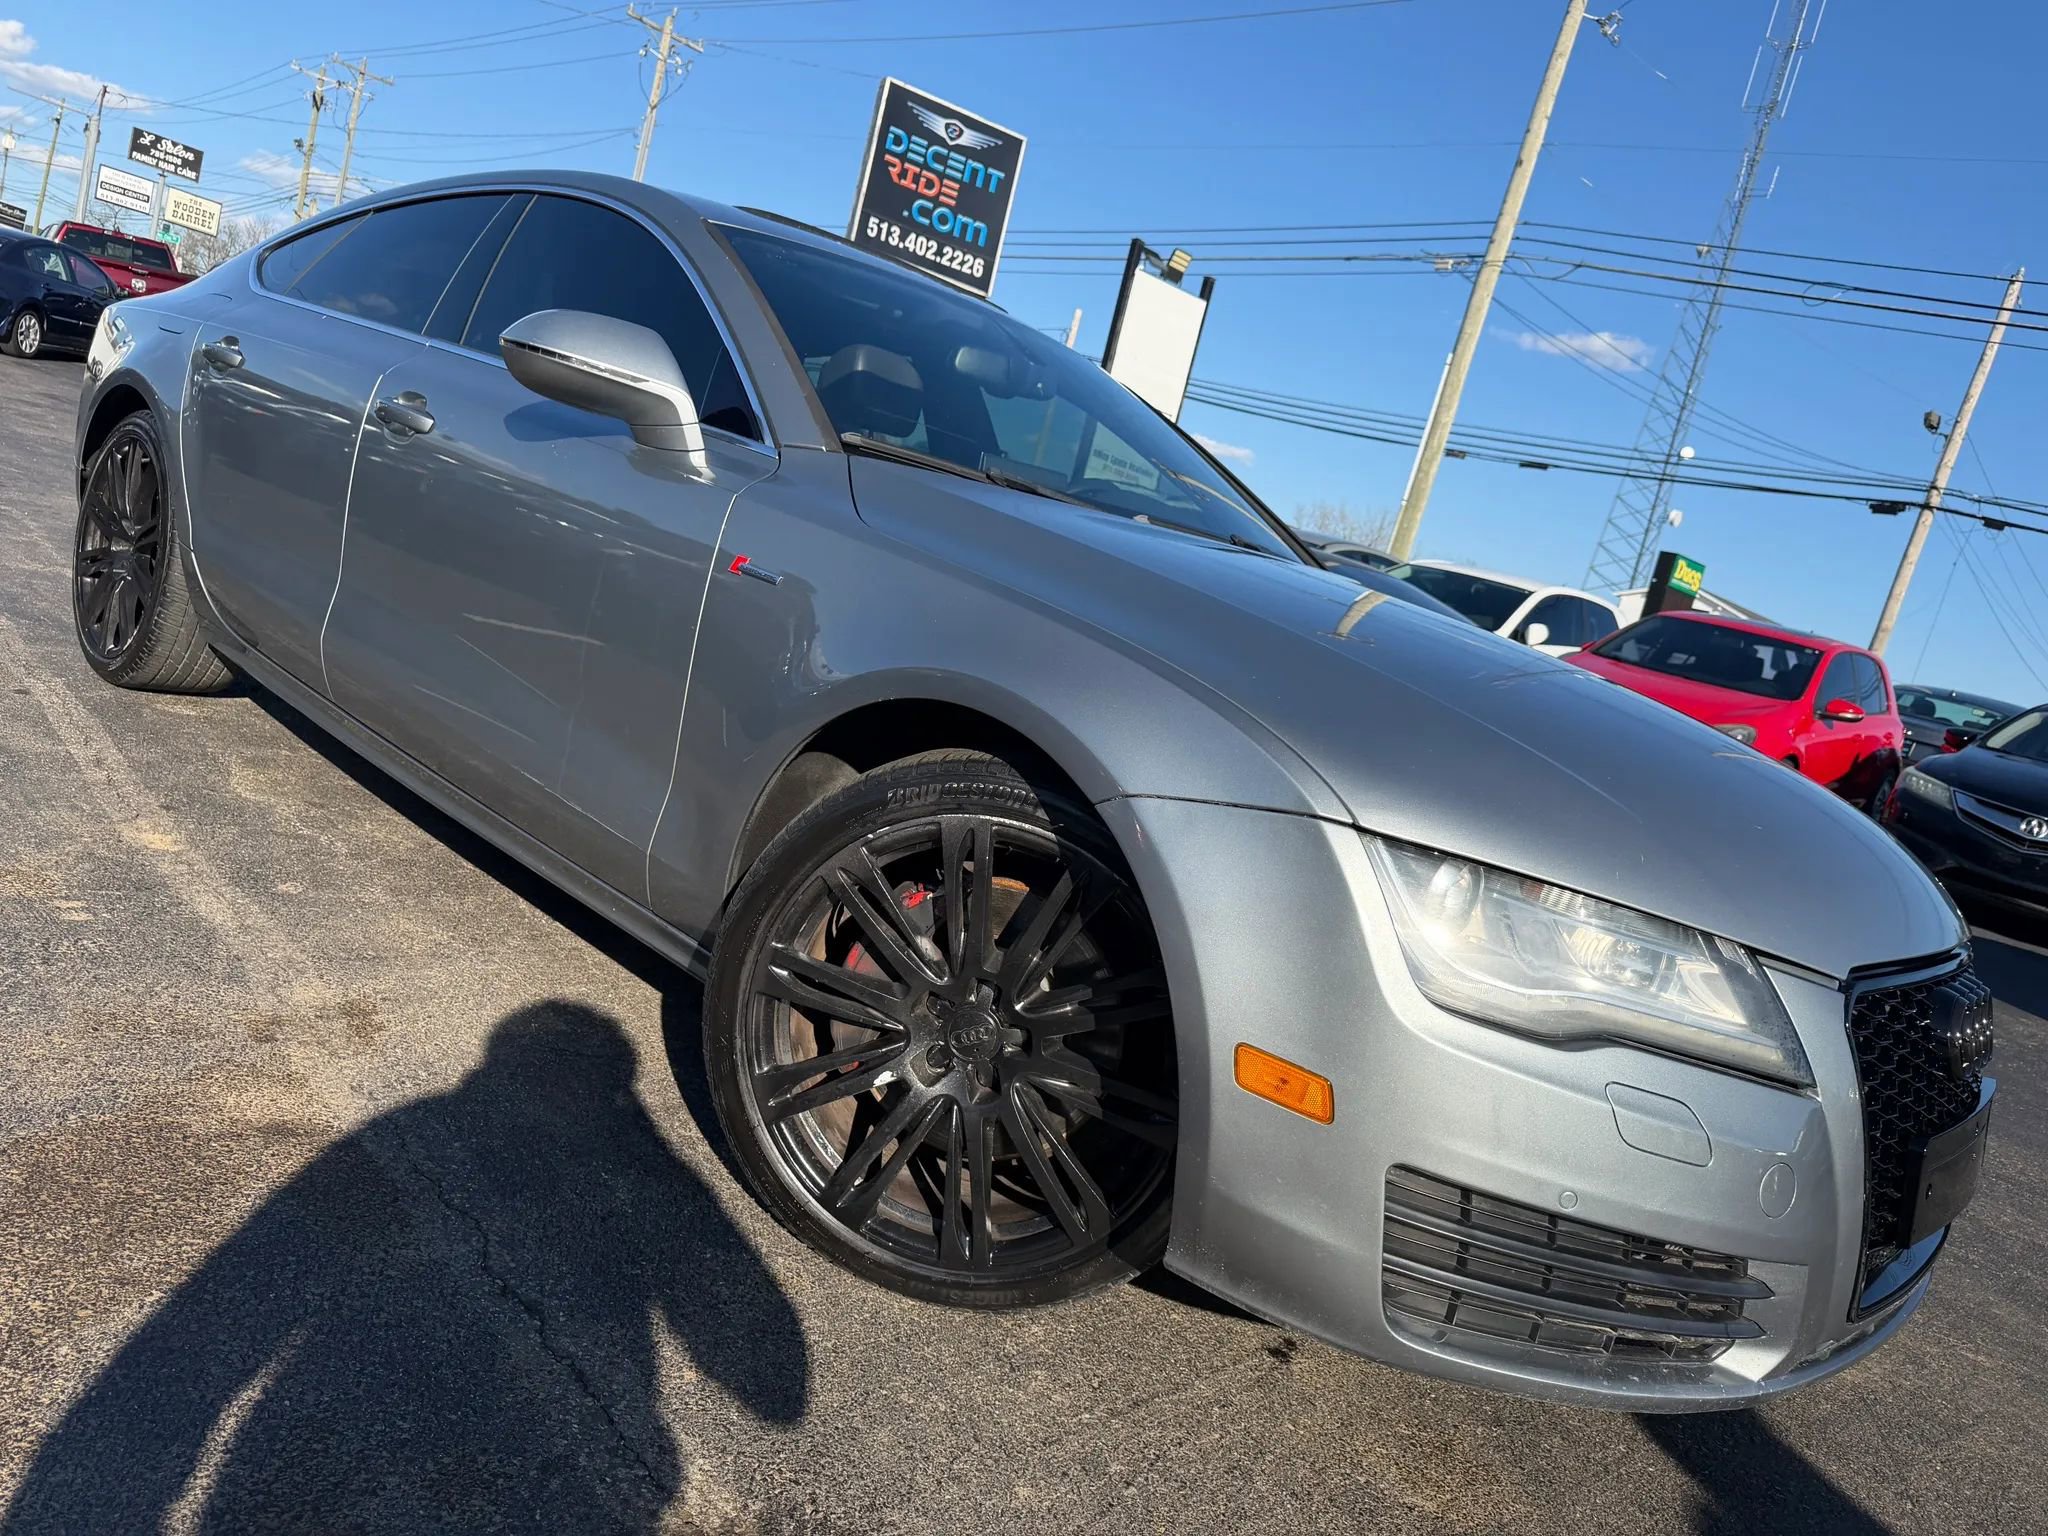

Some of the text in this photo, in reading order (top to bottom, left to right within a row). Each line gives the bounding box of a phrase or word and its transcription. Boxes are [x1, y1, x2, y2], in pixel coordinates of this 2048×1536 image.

[132, 151, 197, 180] FAMILY HAIR CARE
[884, 154, 960, 208] RIDE
[101, 182, 125, 195] DESIGN
[124, 189, 149, 202] CENTER
[174, 200, 215, 220] WOODEN
[190, 199, 202, 207] THE
[172, 210, 212, 229] BARREL
[867, 216, 985, 278] 513.402.2226
